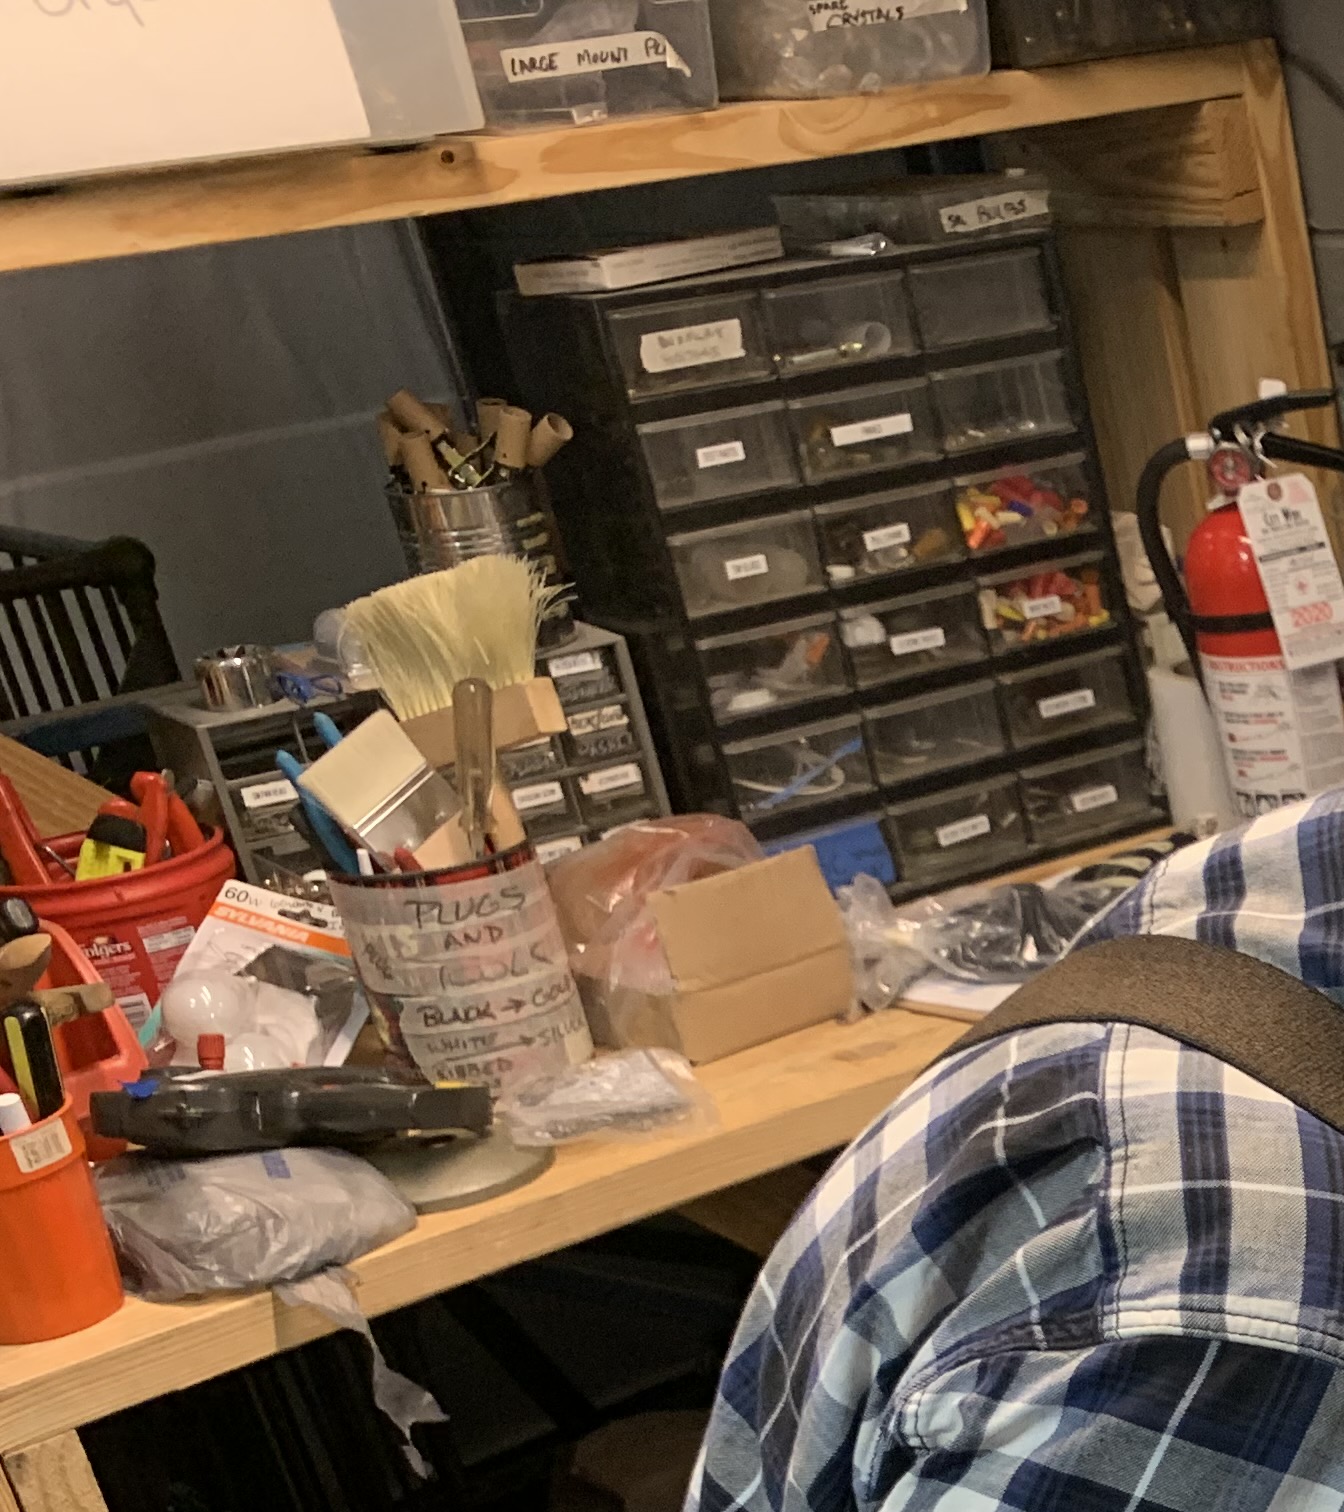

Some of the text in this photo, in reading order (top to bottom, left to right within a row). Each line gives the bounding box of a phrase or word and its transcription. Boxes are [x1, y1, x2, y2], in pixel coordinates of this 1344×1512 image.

[511, 53, 558, 76] LARGE
[577, 47, 629, 66] MOUNT
[1290, 601, 1333, 628] 2020
[404, 886, 527, 929] PLUGS
[214, 905, 310, 942] SYLVANIA
[444, 925, 504, 951] AND
[417, 1001, 497, 1028] BLACK
